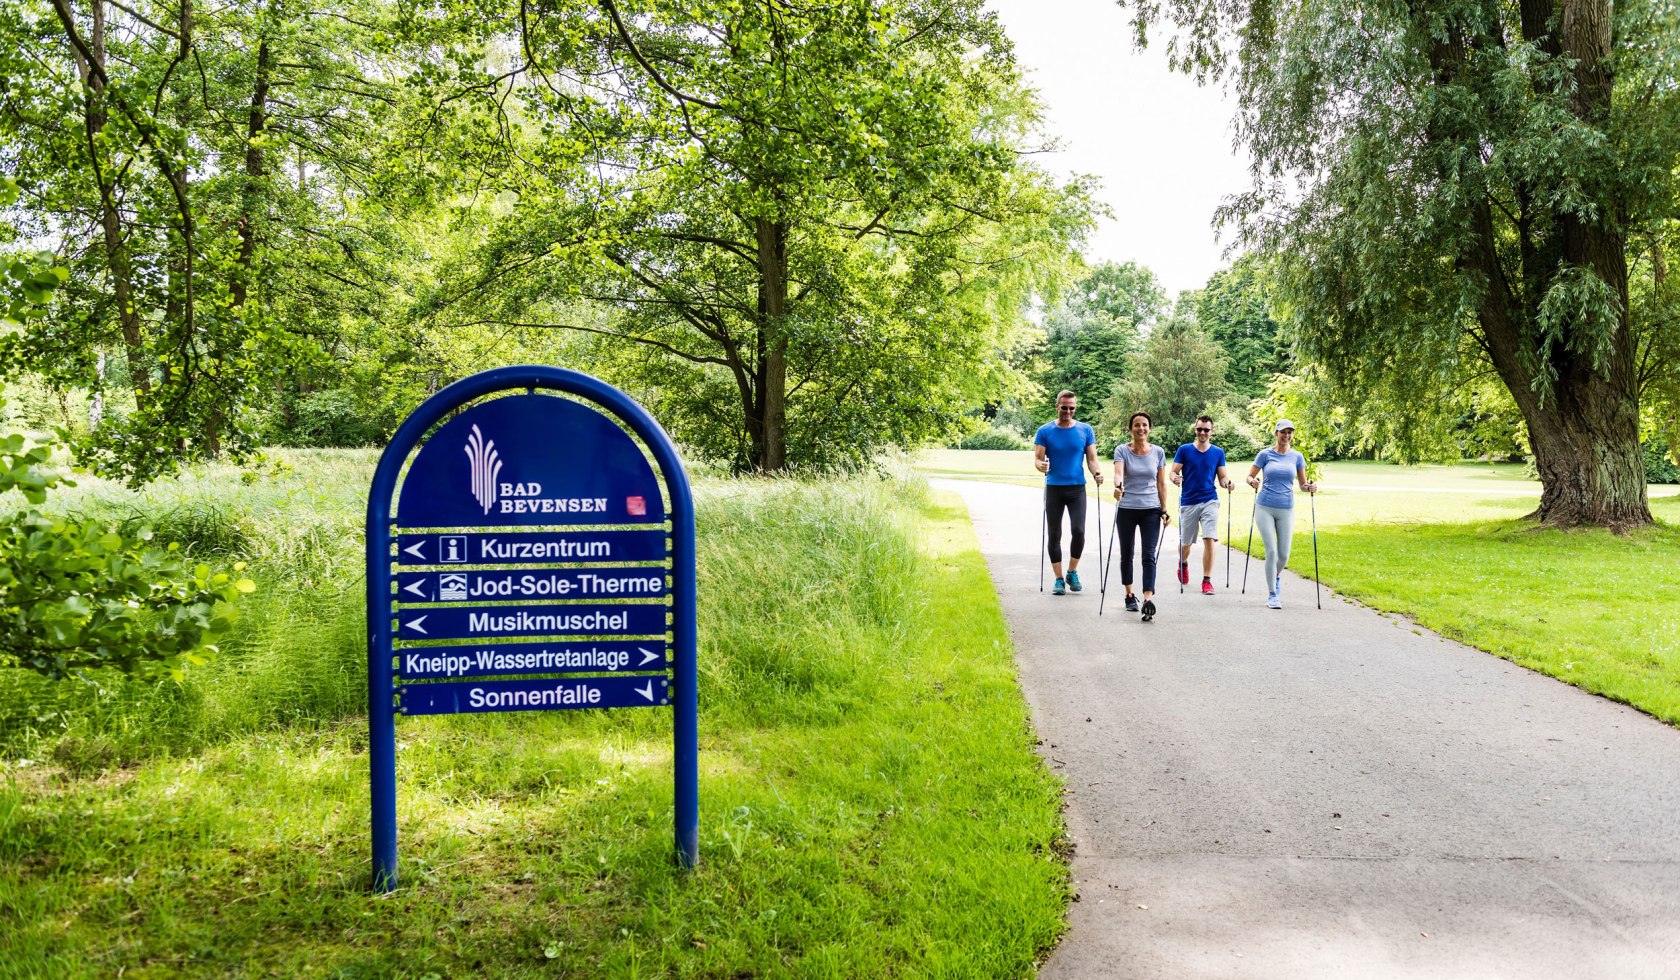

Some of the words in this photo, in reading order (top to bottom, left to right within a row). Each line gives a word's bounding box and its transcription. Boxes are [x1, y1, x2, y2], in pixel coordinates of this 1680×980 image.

[500, 483, 541, 496] BAD
[500, 498, 607, 515] BEVENSEN
[481, 539, 611, 558] Kurzentrum
[470, 575, 662, 596] Jod-Sole-Therme
[469, 611, 628, 632] Musikmuschel
[406, 648, 629, 676] Kneipp-Wassertretanlage
[469, 685, 601, 708] Sonnenfalle
